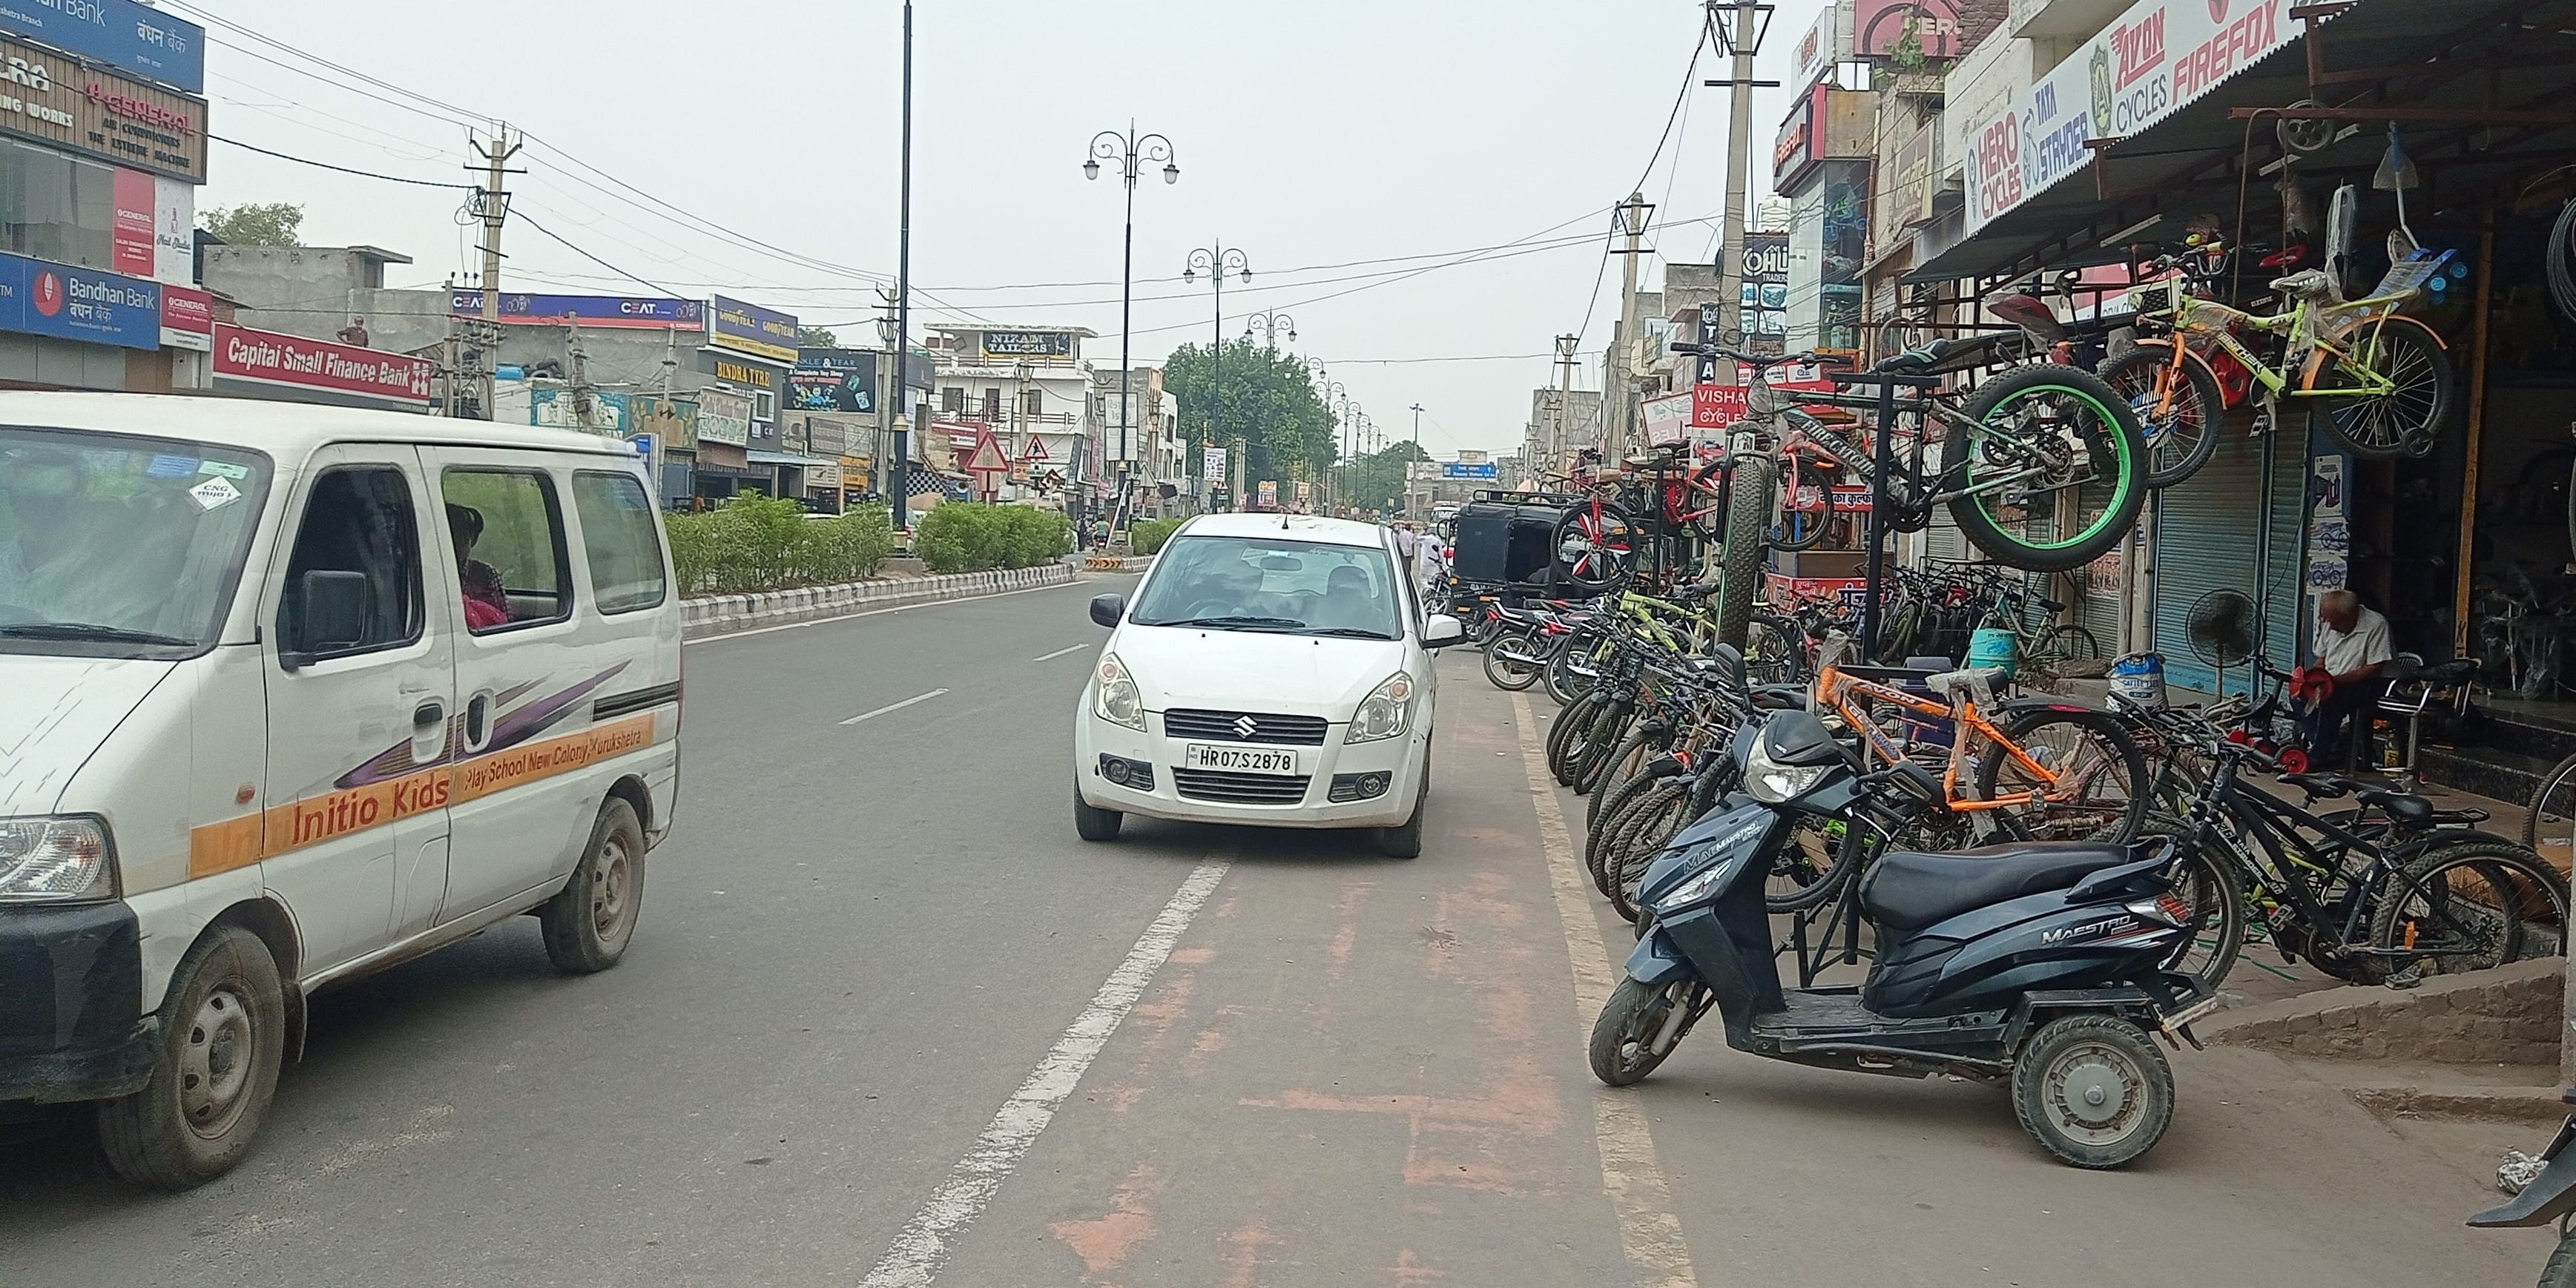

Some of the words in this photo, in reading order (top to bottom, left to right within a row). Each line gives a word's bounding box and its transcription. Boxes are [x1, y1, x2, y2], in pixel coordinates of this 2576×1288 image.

[66, 0, 106, 27] Bank
[2109, 6, 2166, 93] AVON
[2172, 0, 2279, 105] FIREFOX
[27, 102, 73, 127] WORKS
[2035, 81, 2058, 126] TATA
[2116, 74, 2167, 133] CYCLES
[1978, 111, 2018, 184] HERO
[2039, 111, 2090, 182] STRYDER
[1981, 164, 2023, 219] CYCLES
[69, 277, 125, 305] Bandhan
[126, 288, 155, 310] Bank
[1762, 273, 1789, 283] TRADERS
[621, 303, 656, 314] CEAT
[762, 320, 796, 338] GOODYEAR
[991, 334, 1044, 343] NIZAM
[228, 336, 281, 370] Capital
[283, 346, 323, 373] Small
[324, 352, 377, 384] Finance
[378, 361, 409, 387] Bank
[717, 361, 748, 383] BINDRA
[748, 368, 770, 387] TYRE
[823, 358, 831, 369] &
[1697, 389, 1747, 405] VISHA
[203, 484, 228, 492] CNG
[1858, 682, 1917, 704] AVON
[488, 754, 527, 782] School
[527, 752, 551, 772] New
[591, 729, 642, 756] Kurukshetra
[291, 791, 379, 845] Initio
[392, 775, 450, 818] Kids
[2041, 914, 2131, 945] MAESTRO
